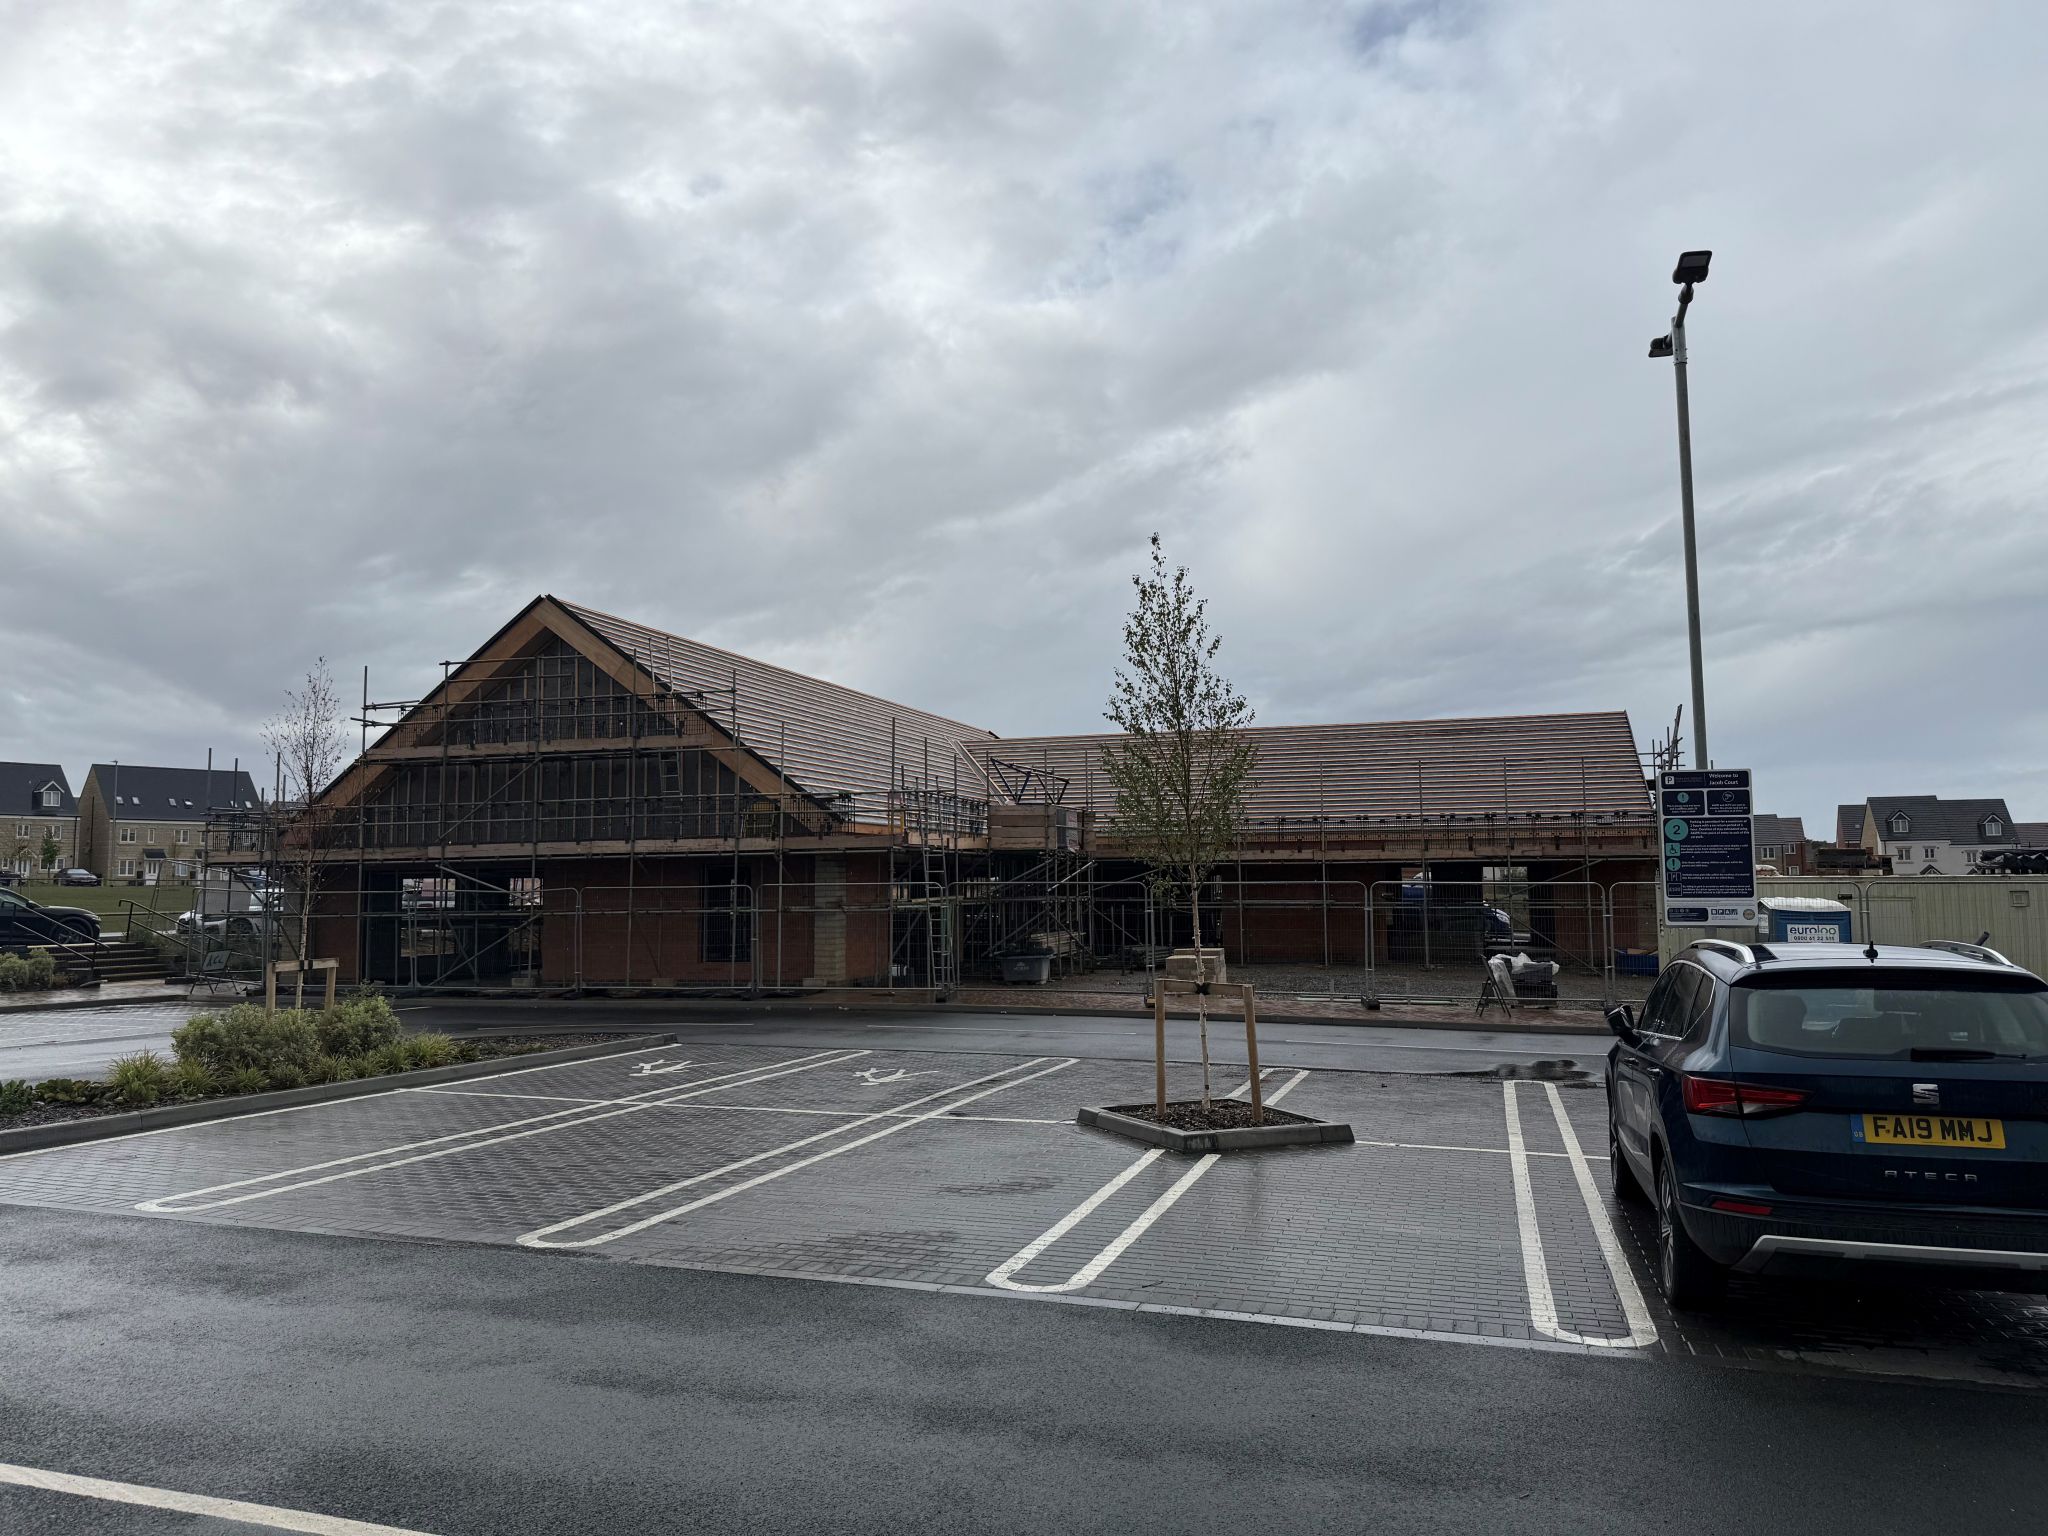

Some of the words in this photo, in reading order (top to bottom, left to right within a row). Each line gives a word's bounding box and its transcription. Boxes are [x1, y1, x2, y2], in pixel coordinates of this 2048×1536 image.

[1672, 825, 1681, 835] 2
[1790, 926, 1837, 935] euroloo
[1872, 1116, 1933, 1140] FA19
[1939, 1118, 1994, 1143] MMJ
[1884, 1170, 1979, 1182] ATECA
